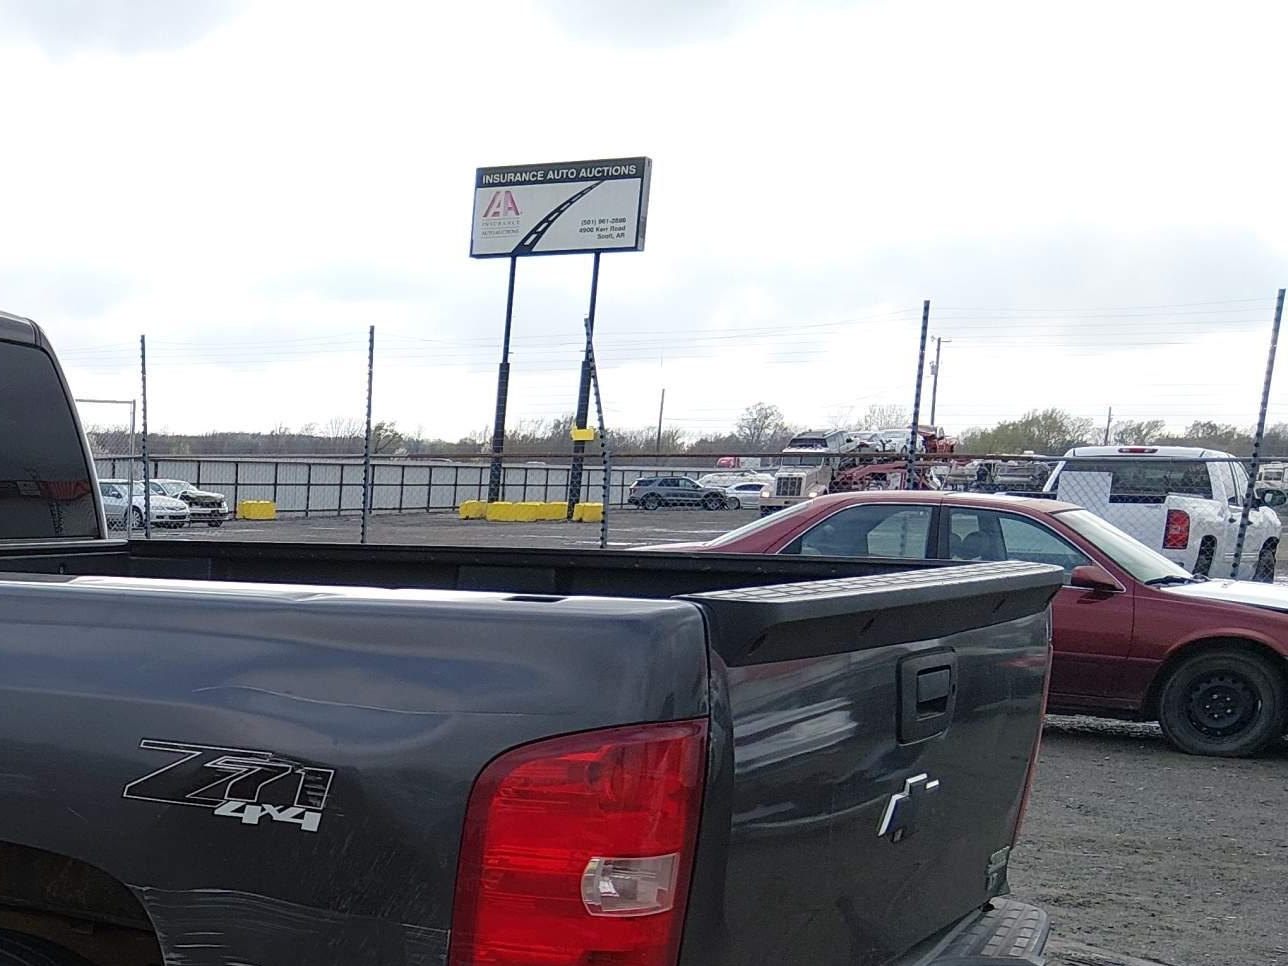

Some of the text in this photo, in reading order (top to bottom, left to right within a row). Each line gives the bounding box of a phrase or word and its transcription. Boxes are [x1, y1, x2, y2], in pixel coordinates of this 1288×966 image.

[482, 165, 637, 185] INSURANCE AUTO AUCTIONS
[123, 738, 335, 811] Z71
